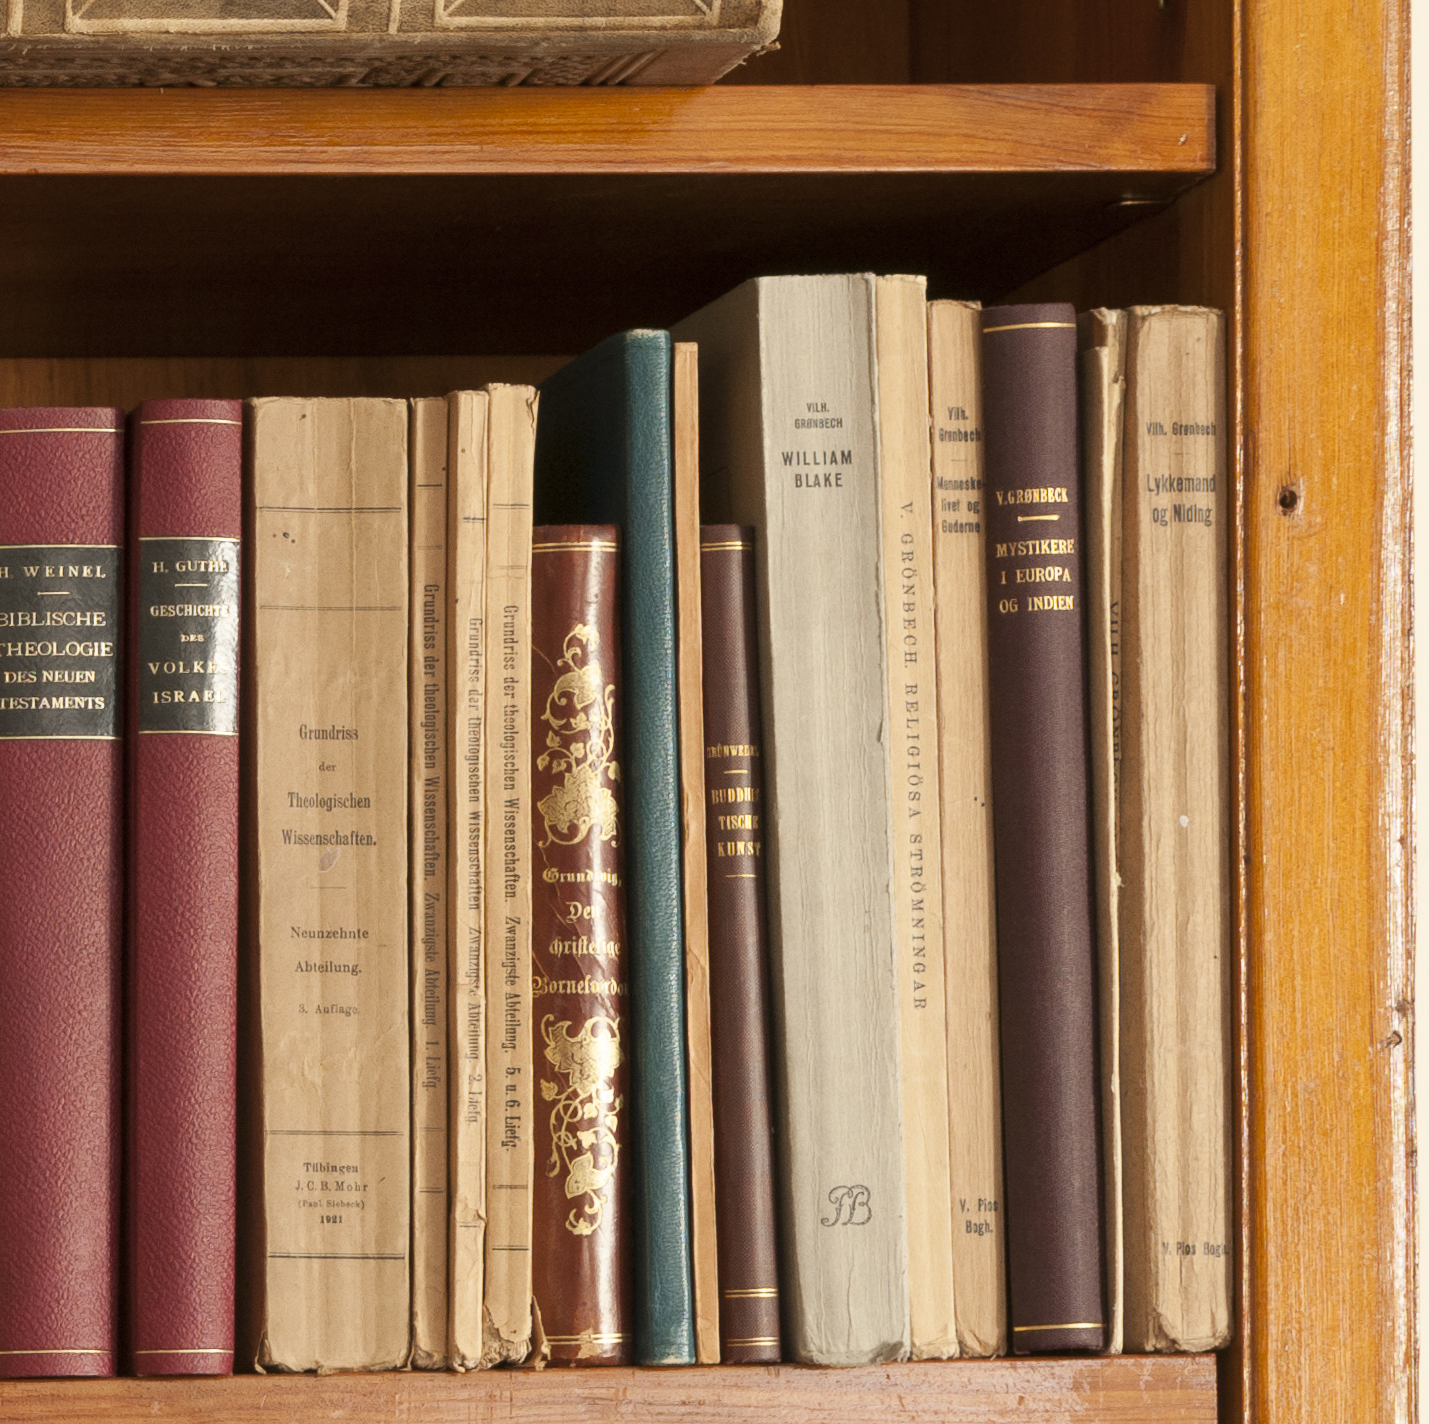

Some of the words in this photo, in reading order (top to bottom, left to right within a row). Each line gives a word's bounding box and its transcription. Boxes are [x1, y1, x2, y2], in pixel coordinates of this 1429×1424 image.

[781, 450, 854, 466] WILLIAM
[794, 473, 843, 488] BLAKE
[1146, 474, 1216, 494] Lykkemand
[1173, 504, 1213, 526] Niding
[996, 539, 1075, 557] MYSTIKERE
[24, 565, 106, 579] WEINEL
[1016, 566, 1072, 583] EUROPA
[1000, 598, 1019, 613] OG
[1028, 595, 1074, 611] INDIEN
[4, 671, 37, 684] DES
[42, 671, 95, 684] NEUEN
[299, 724, 358, 741] Grundriss
[905, 683, 922, 819] RELIGIÖSA
[288, 791, 371, 809] Theologischen
[282, 829, 377, 847] Wissenschaften.
[911, 835, 927, 1009] STRÖMNINGAR
[290, 927, 369, 940] Neunzehnte
[294, 961, 362, 975] Abteilung.
[303, 1162, 358, 1175] Tübingen
